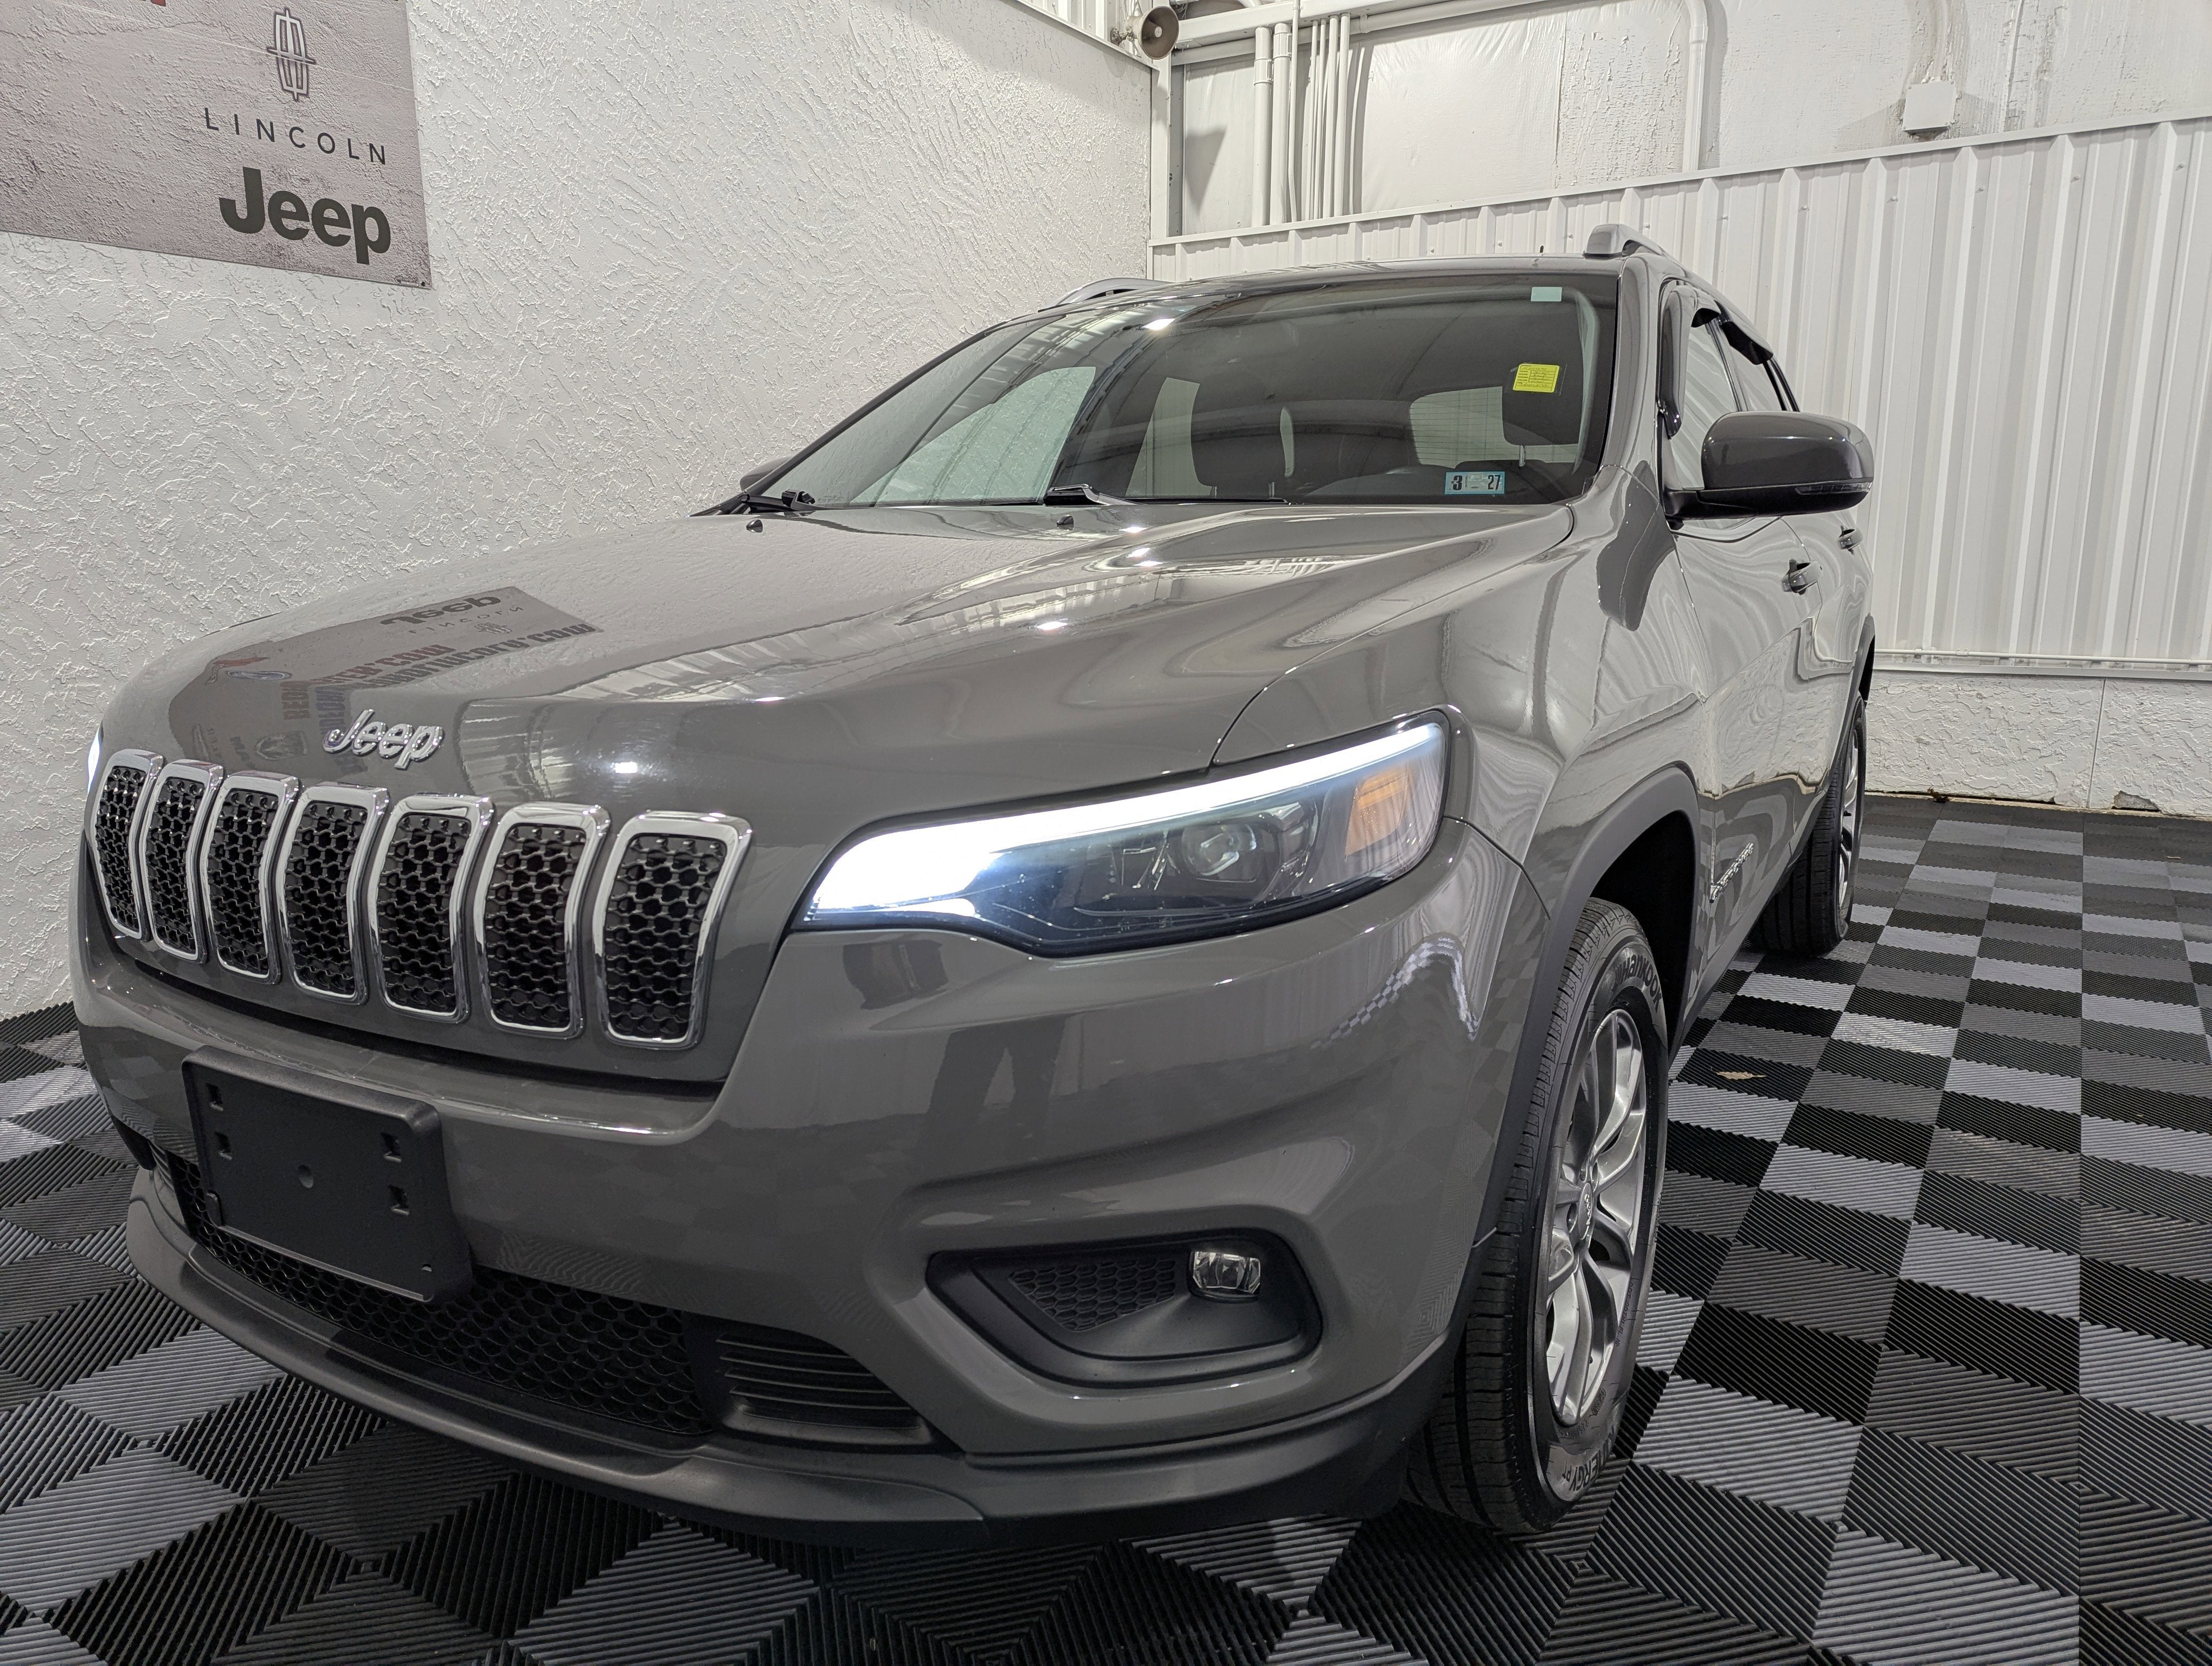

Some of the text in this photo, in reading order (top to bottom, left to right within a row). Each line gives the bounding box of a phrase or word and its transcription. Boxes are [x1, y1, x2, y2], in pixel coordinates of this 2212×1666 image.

[204, 107, 386, 165] LINCOLN
[218, 166, 391, 265] Jeep
[1487, 475, 1501, 490] 27
[323, 708, 445, 770] Jeep
[1562, 1461, 1572, 1482] PT
